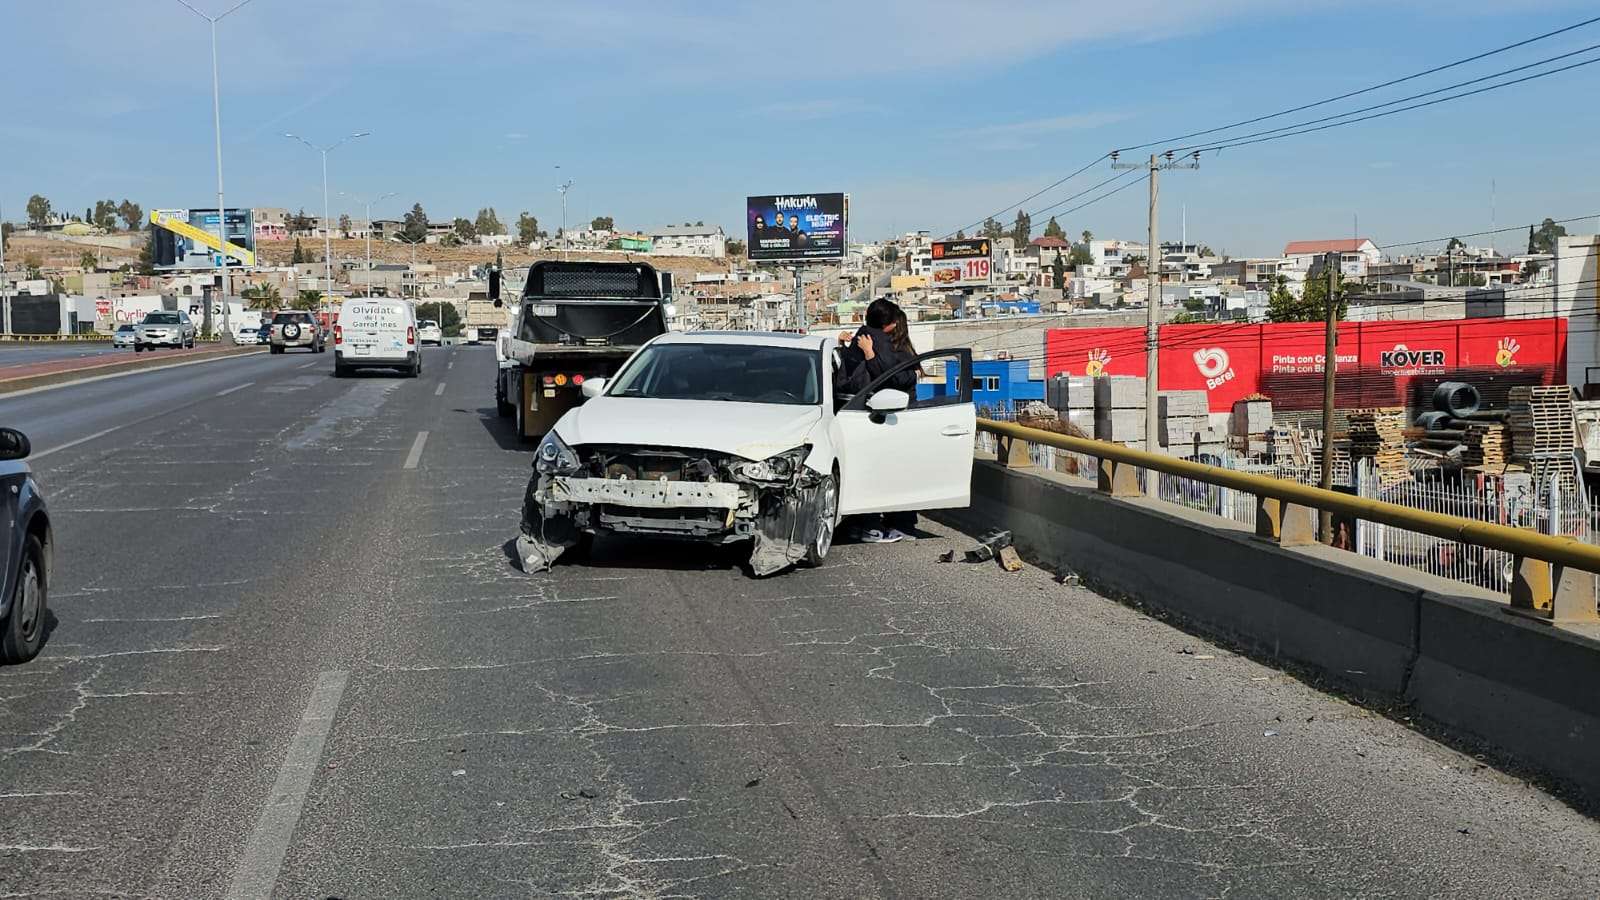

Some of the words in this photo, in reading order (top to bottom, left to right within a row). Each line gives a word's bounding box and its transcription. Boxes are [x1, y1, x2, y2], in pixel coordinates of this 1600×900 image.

[775, 196, 817, 210] HAKUNA
[115, 308, 147, 323] Cyclin
[188, 303, 232, 315] RSA
[1272, 354, 1296, 364] Pinta
[1297, 356, 1313, 364] con
[1314, 354, 1358, 363] Coianza
[1381, 350, 1446, 368] KOVER
[1272, 364, 1296, 374] Pinta
[1314, 364, 1338, 373] Bel
[1206, 367, 1235, 391] Berel
